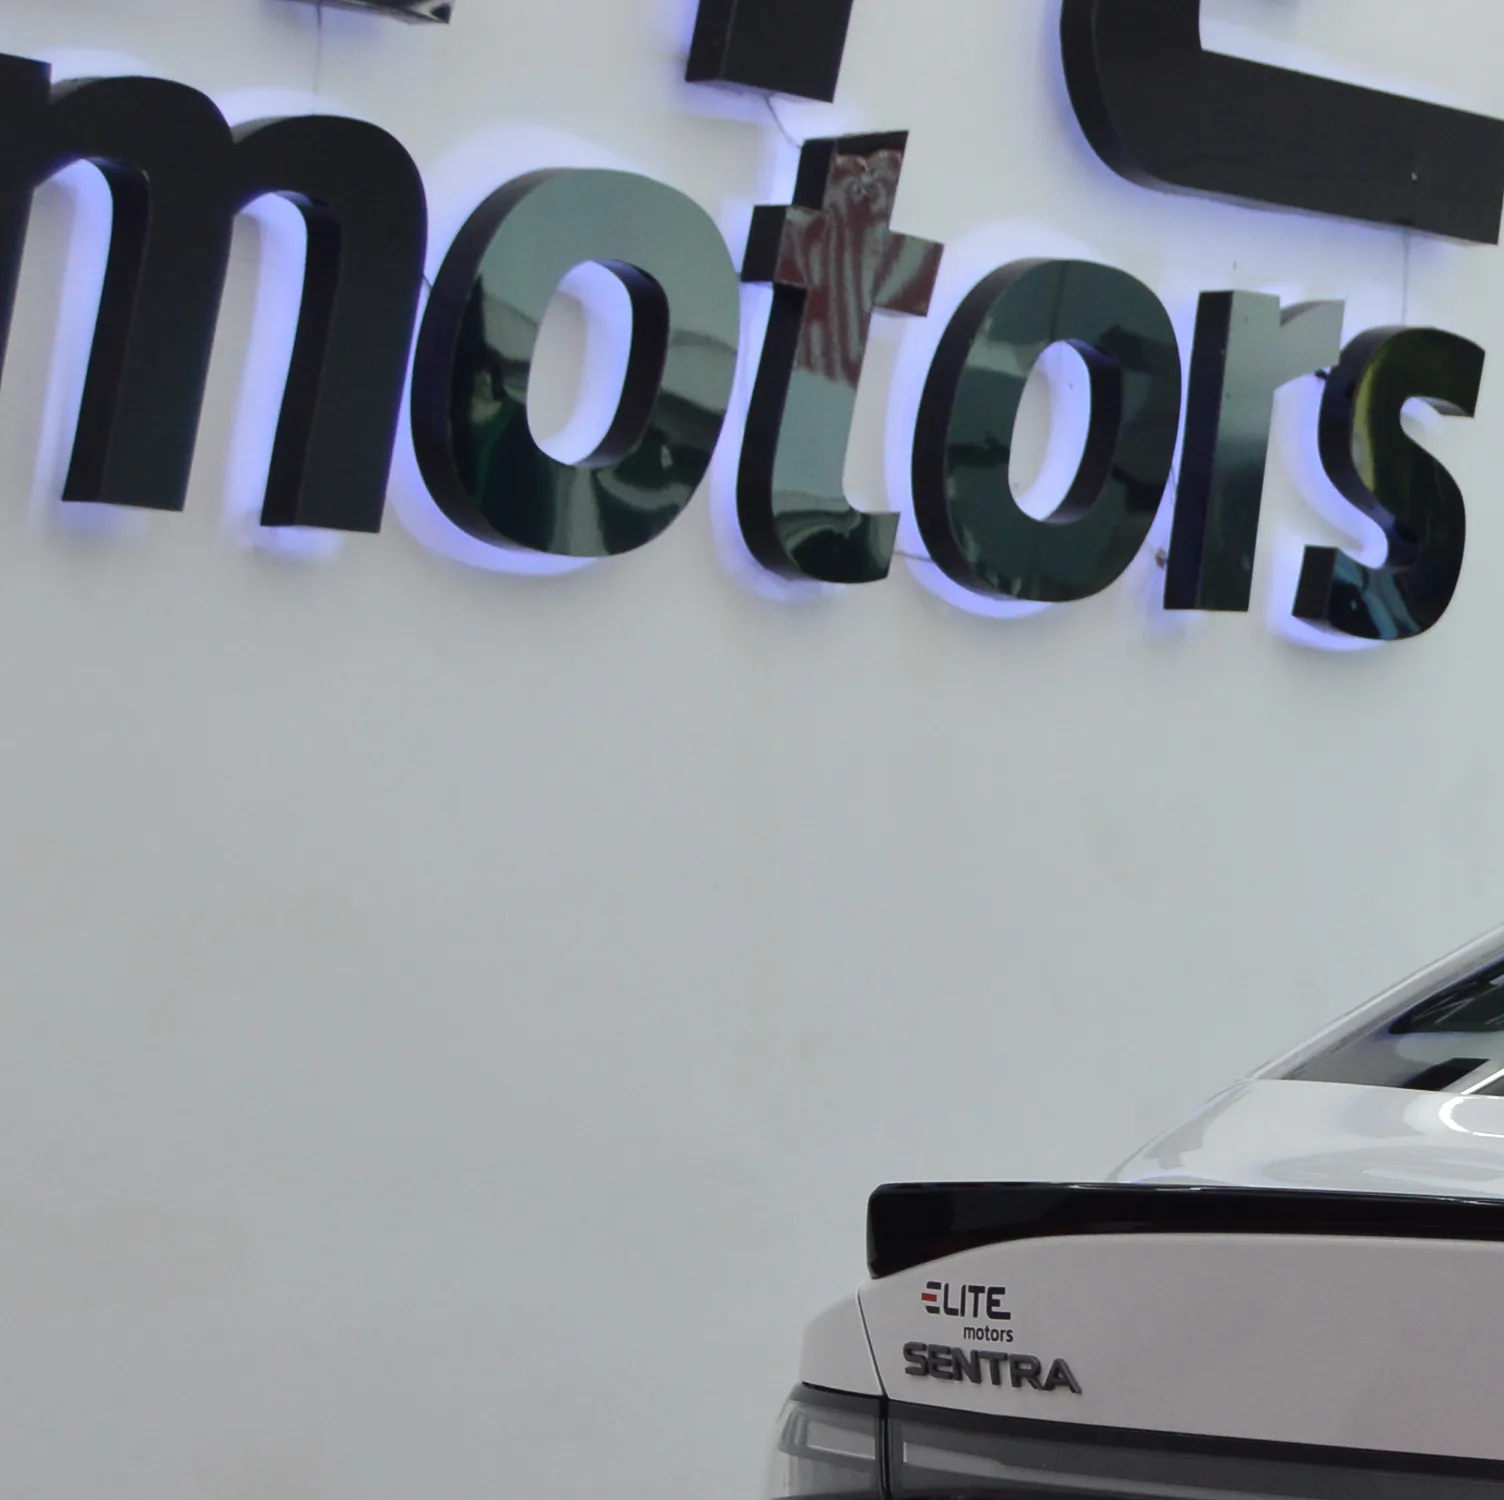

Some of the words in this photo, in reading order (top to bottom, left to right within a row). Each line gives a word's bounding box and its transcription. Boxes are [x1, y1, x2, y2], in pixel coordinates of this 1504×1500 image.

[0, 52, 1486, 641] motors
[921, 1281, 1012, 1320] ELITE
[963, 1324, 1014, 1343] motors
[903, 1341, 1082, 1394] SENTRA
